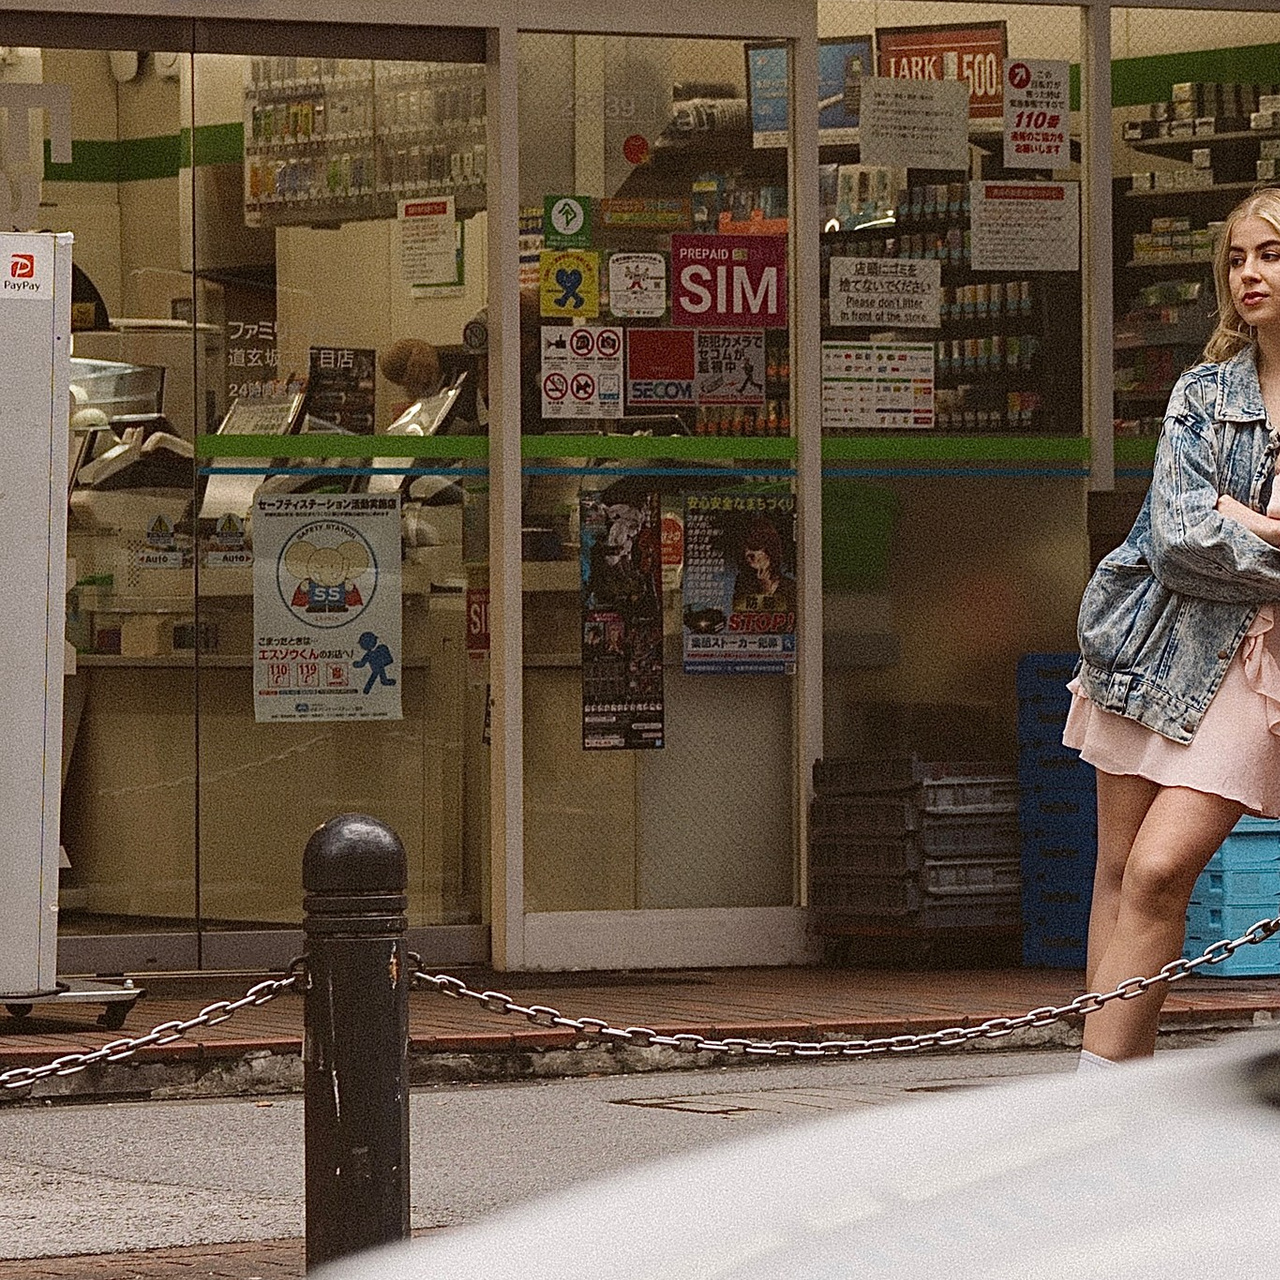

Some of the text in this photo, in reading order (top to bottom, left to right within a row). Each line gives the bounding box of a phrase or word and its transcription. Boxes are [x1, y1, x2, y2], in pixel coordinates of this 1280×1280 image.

[1015, 111, 1060, 129] 110番
[679, 247, 729, 260] PREPAID
[4, 280, 41, 293] PayPay
[679, 264, 778, 315] SIM
[699, 349, 745, 361] セコムが
[632, 381, 692, 399] SECOM
[314, 587, 340, 602] SS
[470, 603, 490, 635] SI
[728, 613, 795, 633] STOP!
[270, 664, 288, 676] 110
